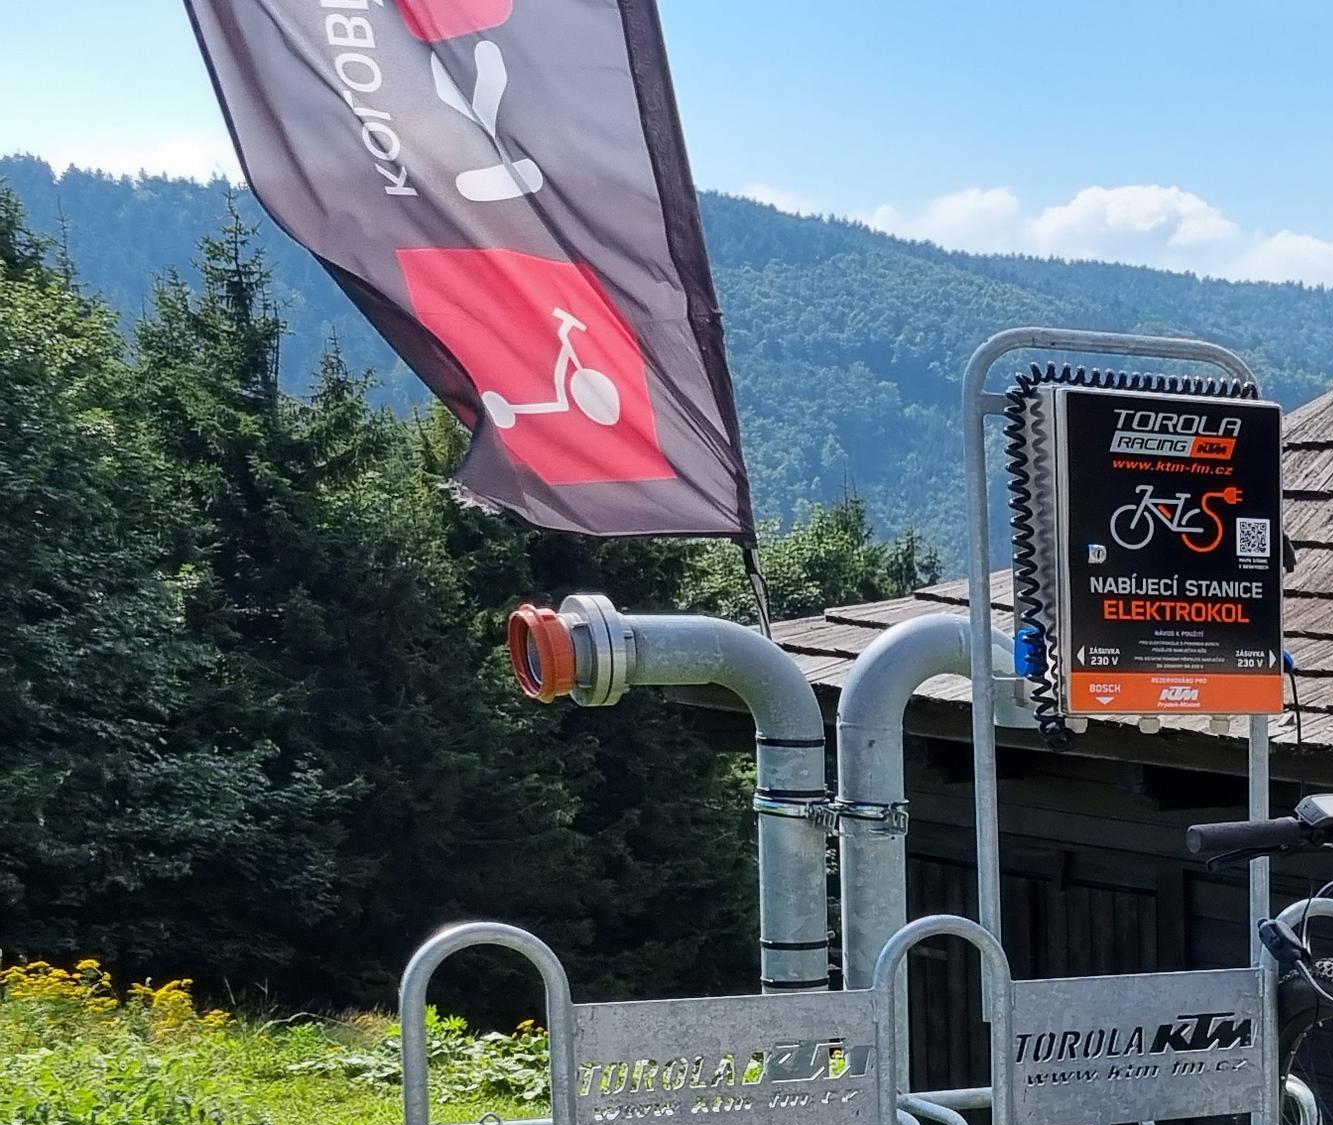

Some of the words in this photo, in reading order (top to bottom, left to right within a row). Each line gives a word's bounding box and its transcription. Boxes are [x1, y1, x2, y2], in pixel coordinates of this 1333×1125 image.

[1114, 409, 1242, 436] TOROLA
[1117, 436, 1188, 452] RACING
[1197, 442, 1228, 454] KTM
[1112, 459, 1234, 476] www.ktm-fm.cz
[1090, 573, 1178, 596] NABÍJECÍ
[1185, 580, 1263, 598] STANICE
[1104, 600, 1249, 623] ELEKTROKOL
[1089, 646, 1120, 655] ZÁSUVKA
[1235, 649, 1265, 657] ZÁSUVKA
[1091, 656, 1109, 665] 230
[1112, 657, 1119, 665] V
[1238, 659, 1255, 668] 230
[1256, 660, 1264, 668] V
[1089, 684, 1120, 693] BOSCH
[1160, 686, 1199, 701] KTM
[1016, 1026, 1144, 1064] TOROLA
[1150, 1012, 1257, 1055] KTM
[580, 1050, 736, 1096] TOROLA
